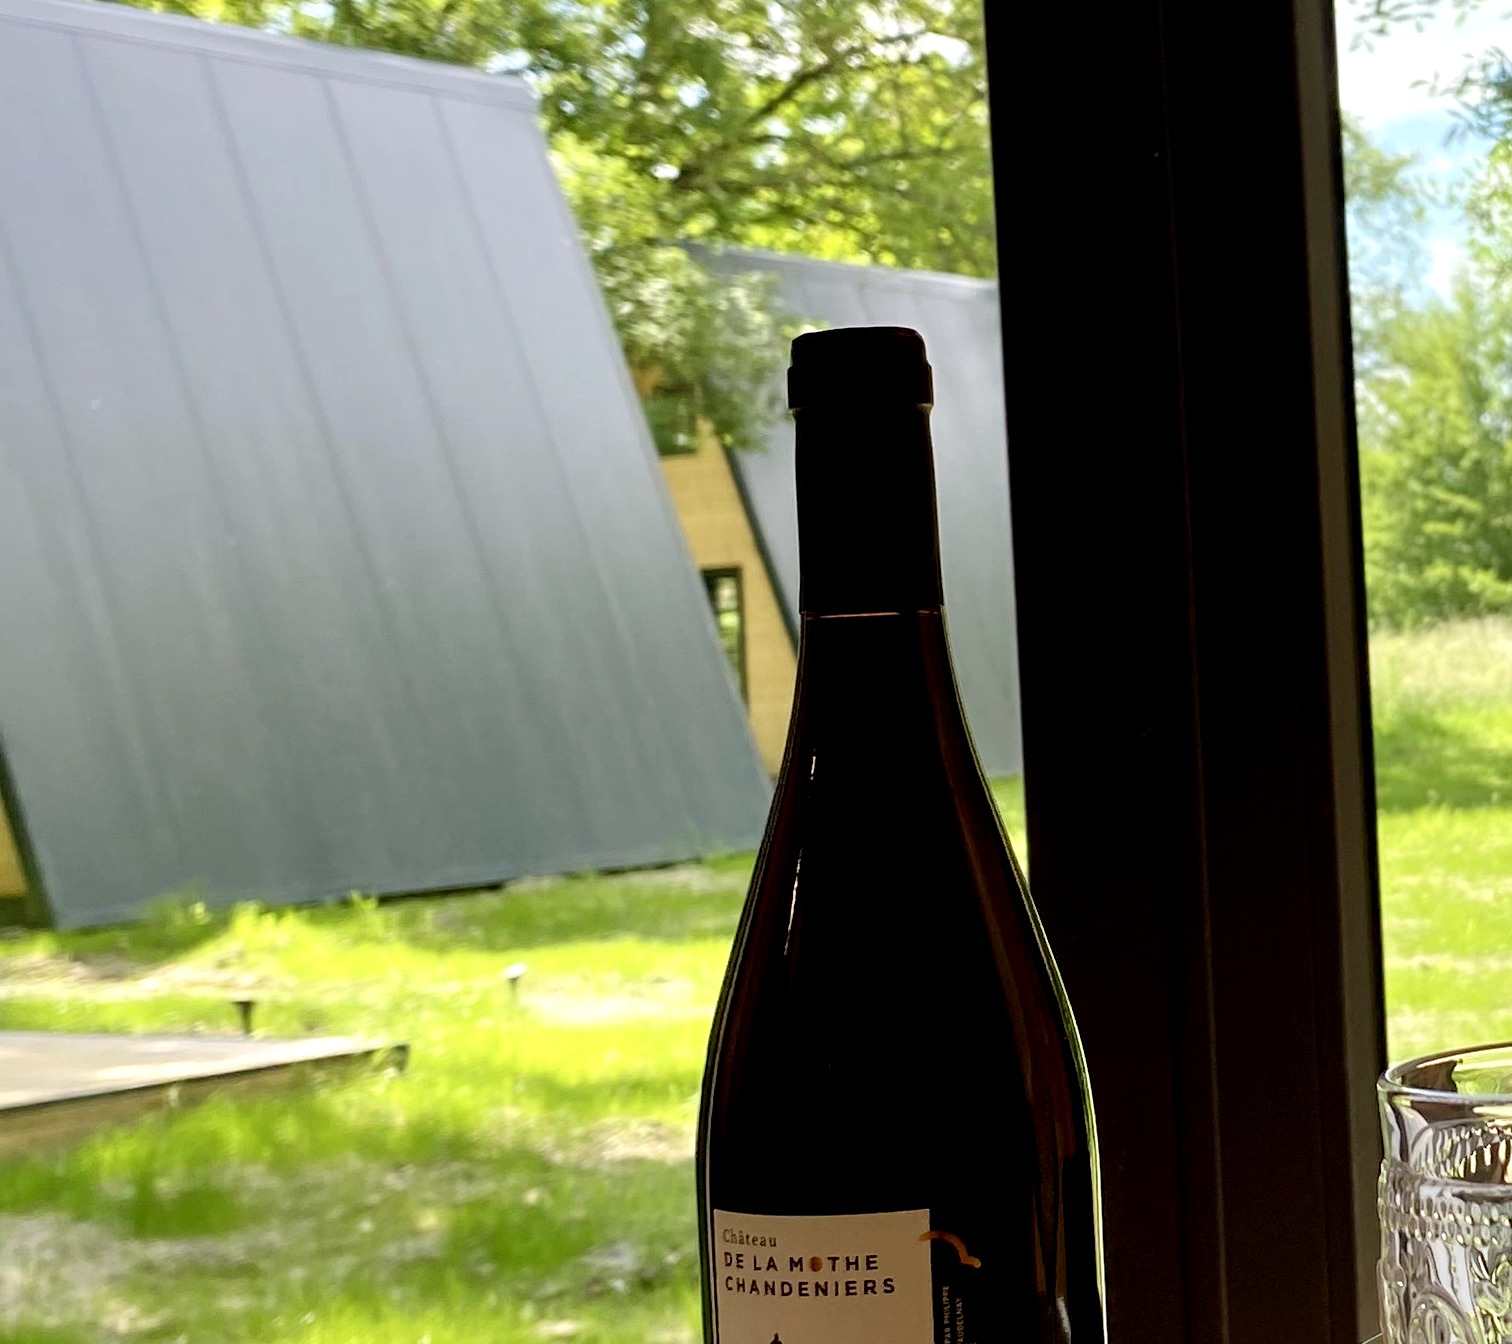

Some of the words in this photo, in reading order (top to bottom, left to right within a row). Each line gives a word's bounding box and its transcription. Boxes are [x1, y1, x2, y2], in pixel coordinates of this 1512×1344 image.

[722, 1228, 777, 1248] Château
[724, 1252, 744, 1269] DE
[753, 1256, 778, 1272] LA
[725, 1275, 895, 1297] CHANDENIERS
[942, 1285, 950, 1325] PHILIPPE
